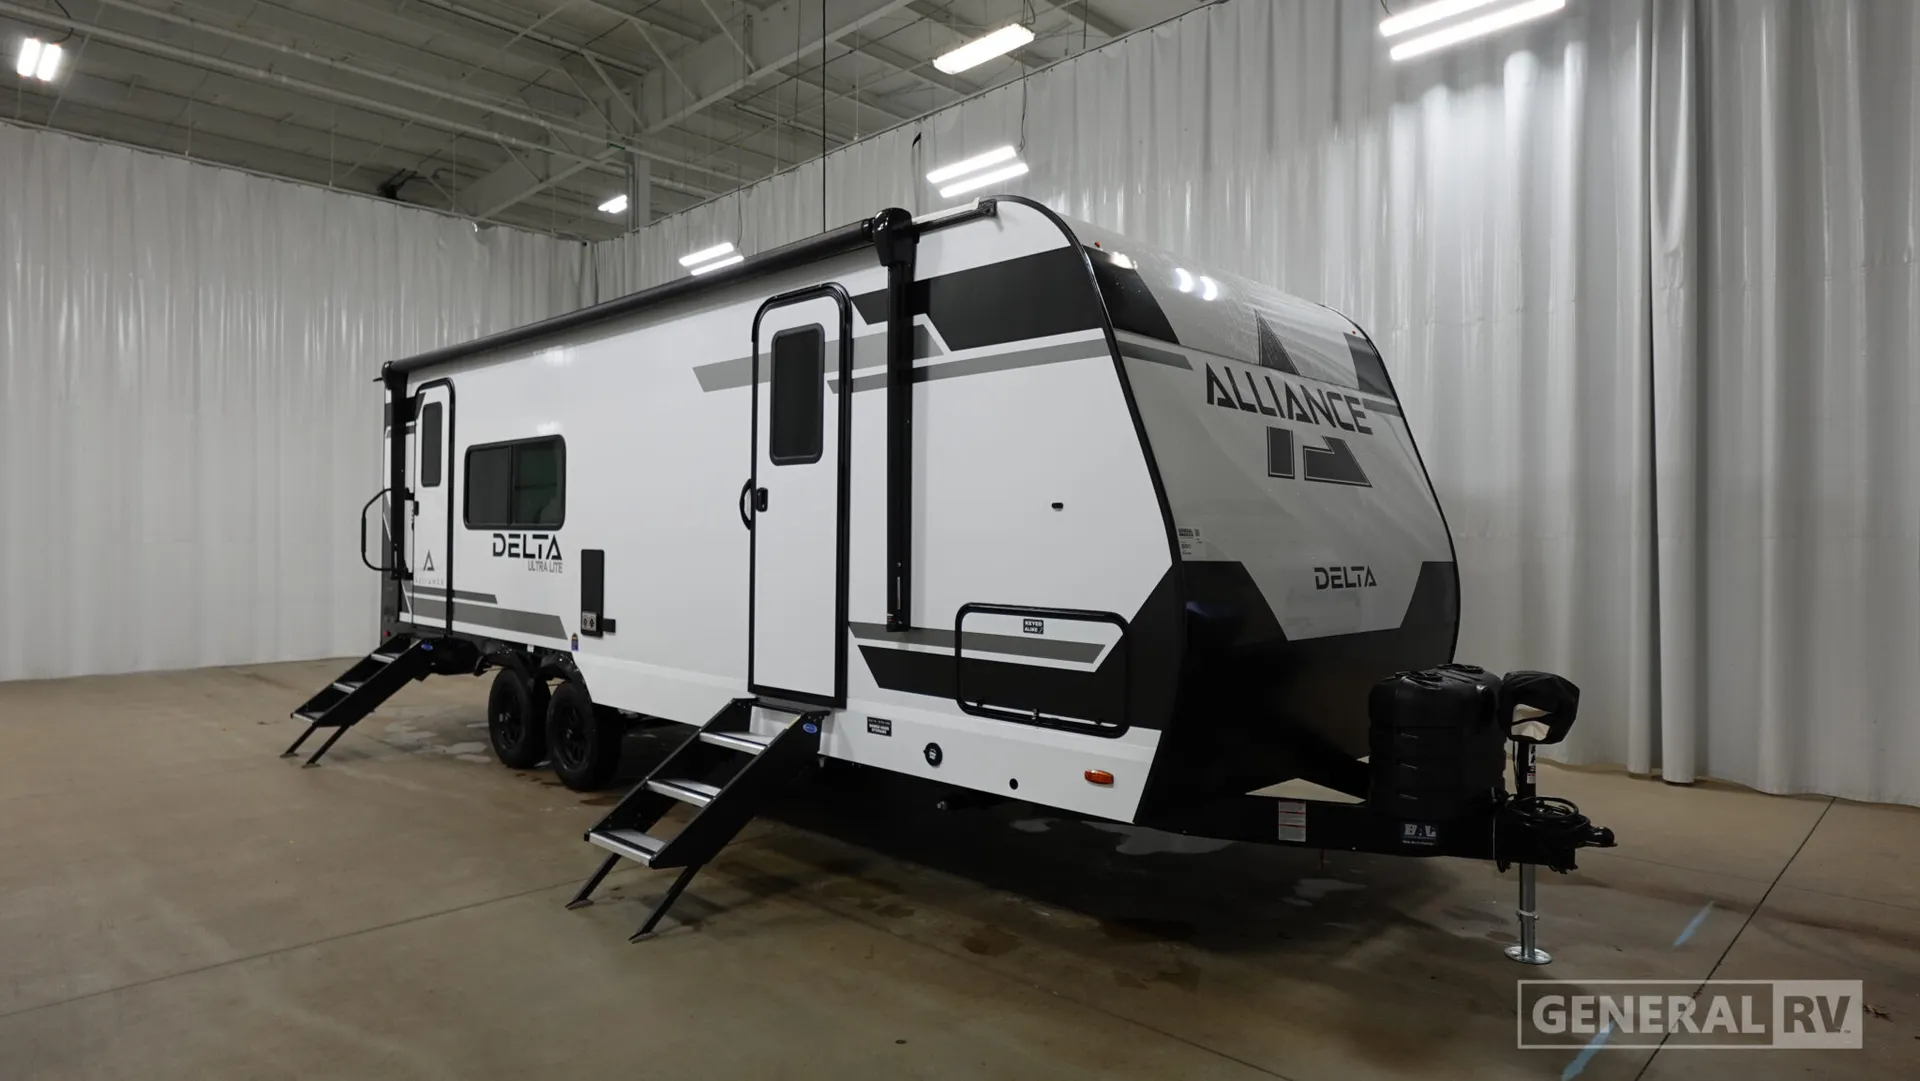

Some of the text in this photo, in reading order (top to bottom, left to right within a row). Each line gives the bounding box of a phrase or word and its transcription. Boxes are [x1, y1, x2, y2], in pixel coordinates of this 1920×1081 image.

[1205, 361, 1374, 435] ALLIANCE
[493, 533, 563, 560] DELTA
[528, 560, 563, 573] ULTRA LITE
[1314, 565, 1378, 590] DELTA
